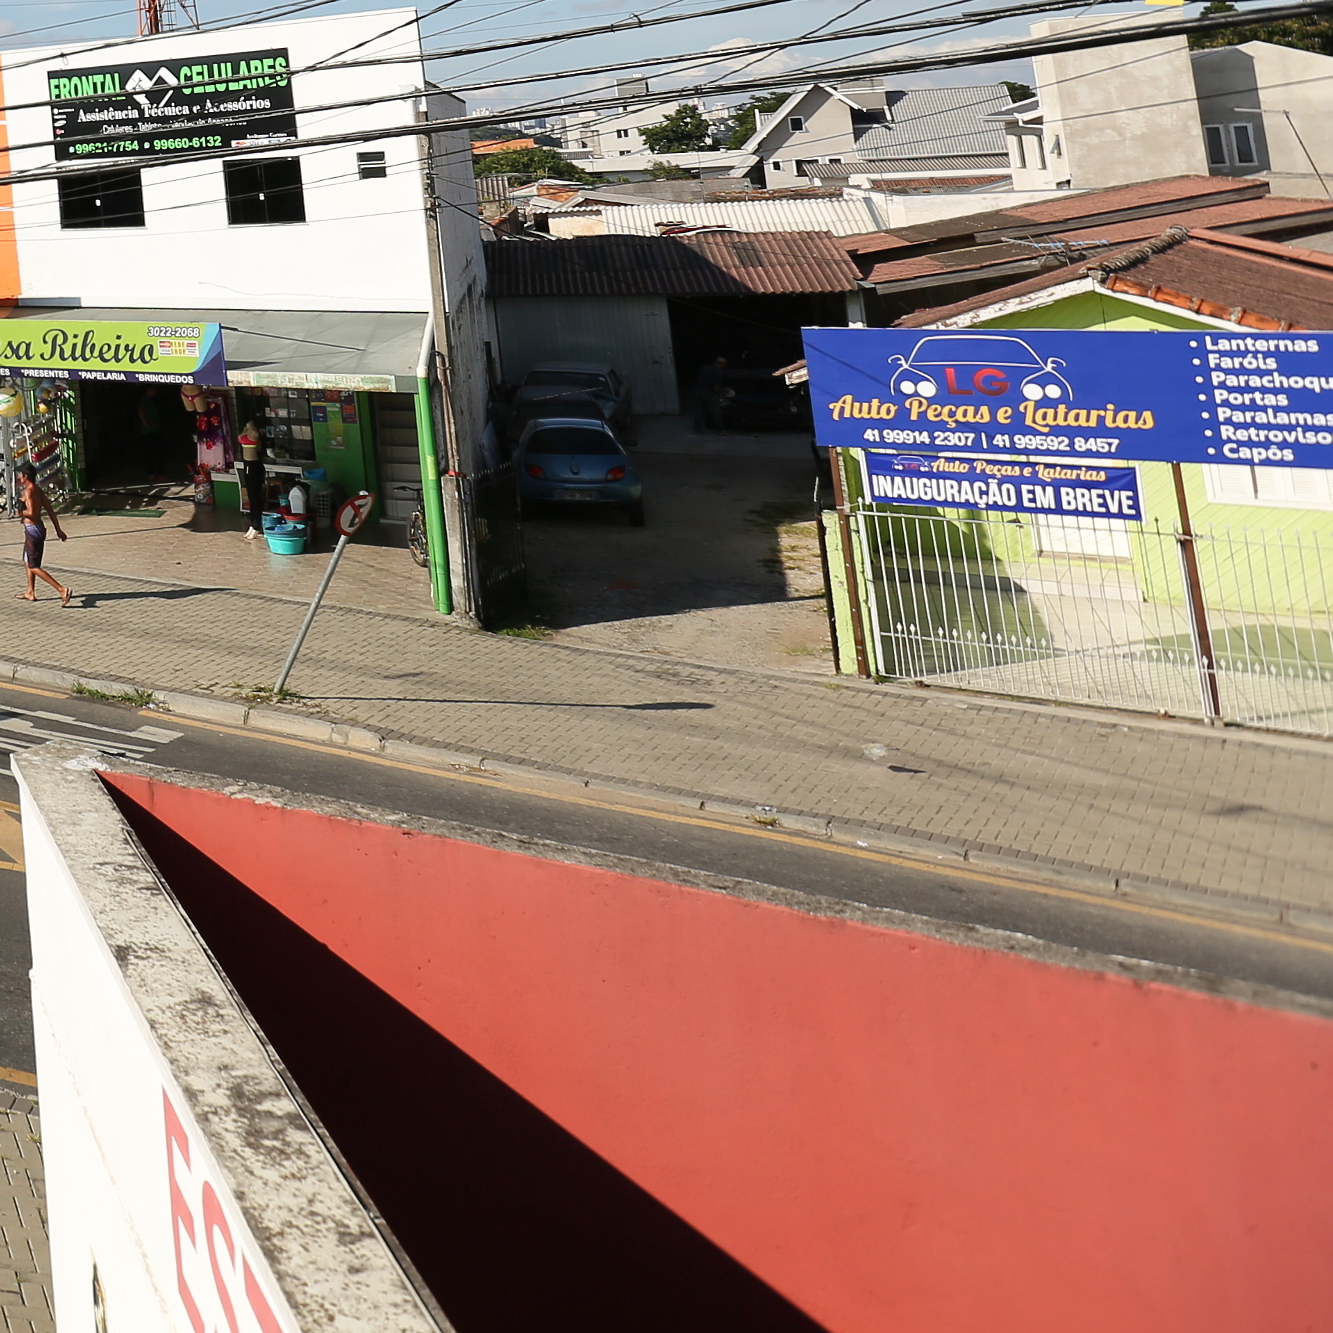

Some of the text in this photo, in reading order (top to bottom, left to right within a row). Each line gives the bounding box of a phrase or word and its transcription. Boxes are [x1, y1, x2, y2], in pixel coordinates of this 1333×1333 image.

[50, 73, 126, 102] FRONTAL
[180, 57, 288, 95] CELULARES
[78, 106, 139, 122] Assistência
[141, 103, 190, 118] Técnica
[204, 96, 271, 113] Acessórios
[153, 135, 222, 150] 99660-6132
[147, 326, 200, 338] 3022-2068
[1204, 335, 1319, 353] Lanternas
[39, 328, 158, 364] Ribeiro
[1208, 353, 1278, 370] Faróis
[944, 367, 1009, 396] LG
[1213, 388, 1289, 407] Portas
[828, 394, 1155, 433] Auto Peças e Latarias
[863, 428, 1120, 453] 41 99914 2307 41 99592 8457
[1222, 442, 1295, 464] Capôs
[930, 457, 1107, 482] Auto Peças e Latarias
[871, 474, 1137, 515] INAUGURAÇÃO EM BREVE
